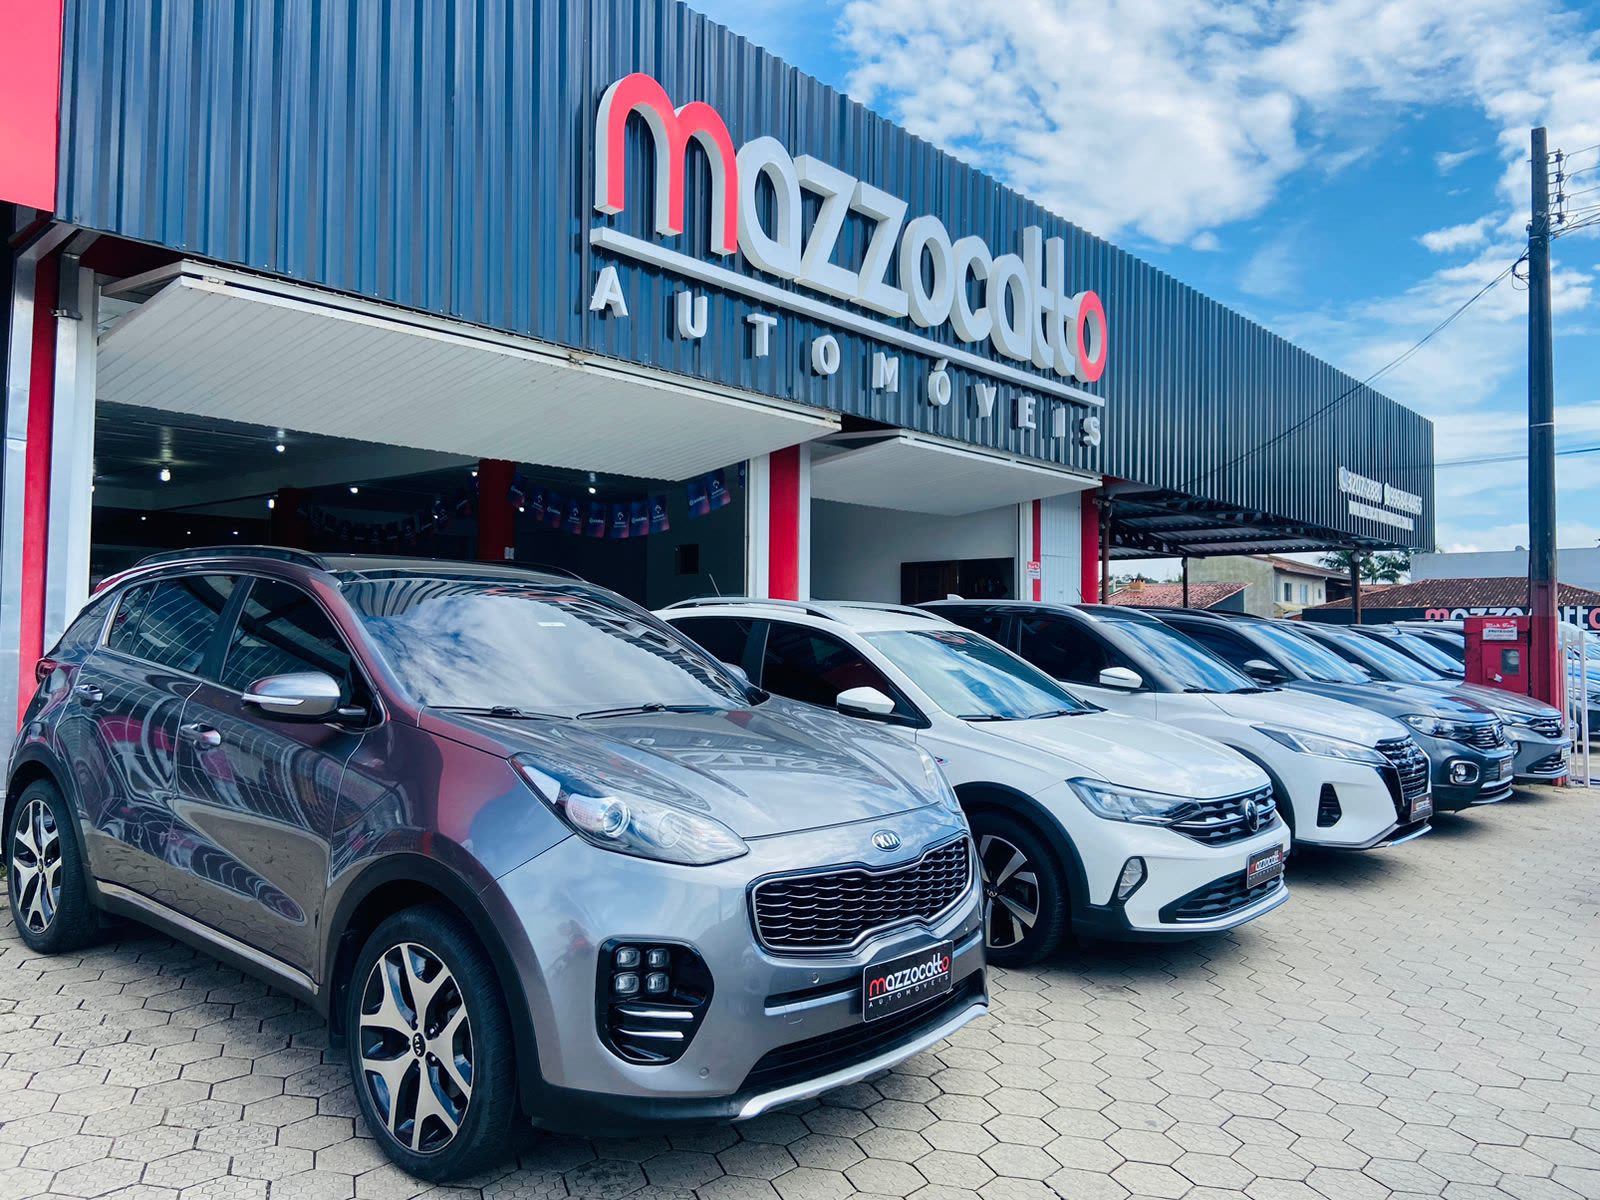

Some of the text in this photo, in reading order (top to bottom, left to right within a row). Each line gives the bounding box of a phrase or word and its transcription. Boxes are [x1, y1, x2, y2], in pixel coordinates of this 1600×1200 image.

[595, 72, 1108, 383] mazzocatto
[589, 266, 1102, 447] AUTOMÓVEIS
[875, 832, 900, 848] KIA
[869, 952, 950, 997] mazzocatto
